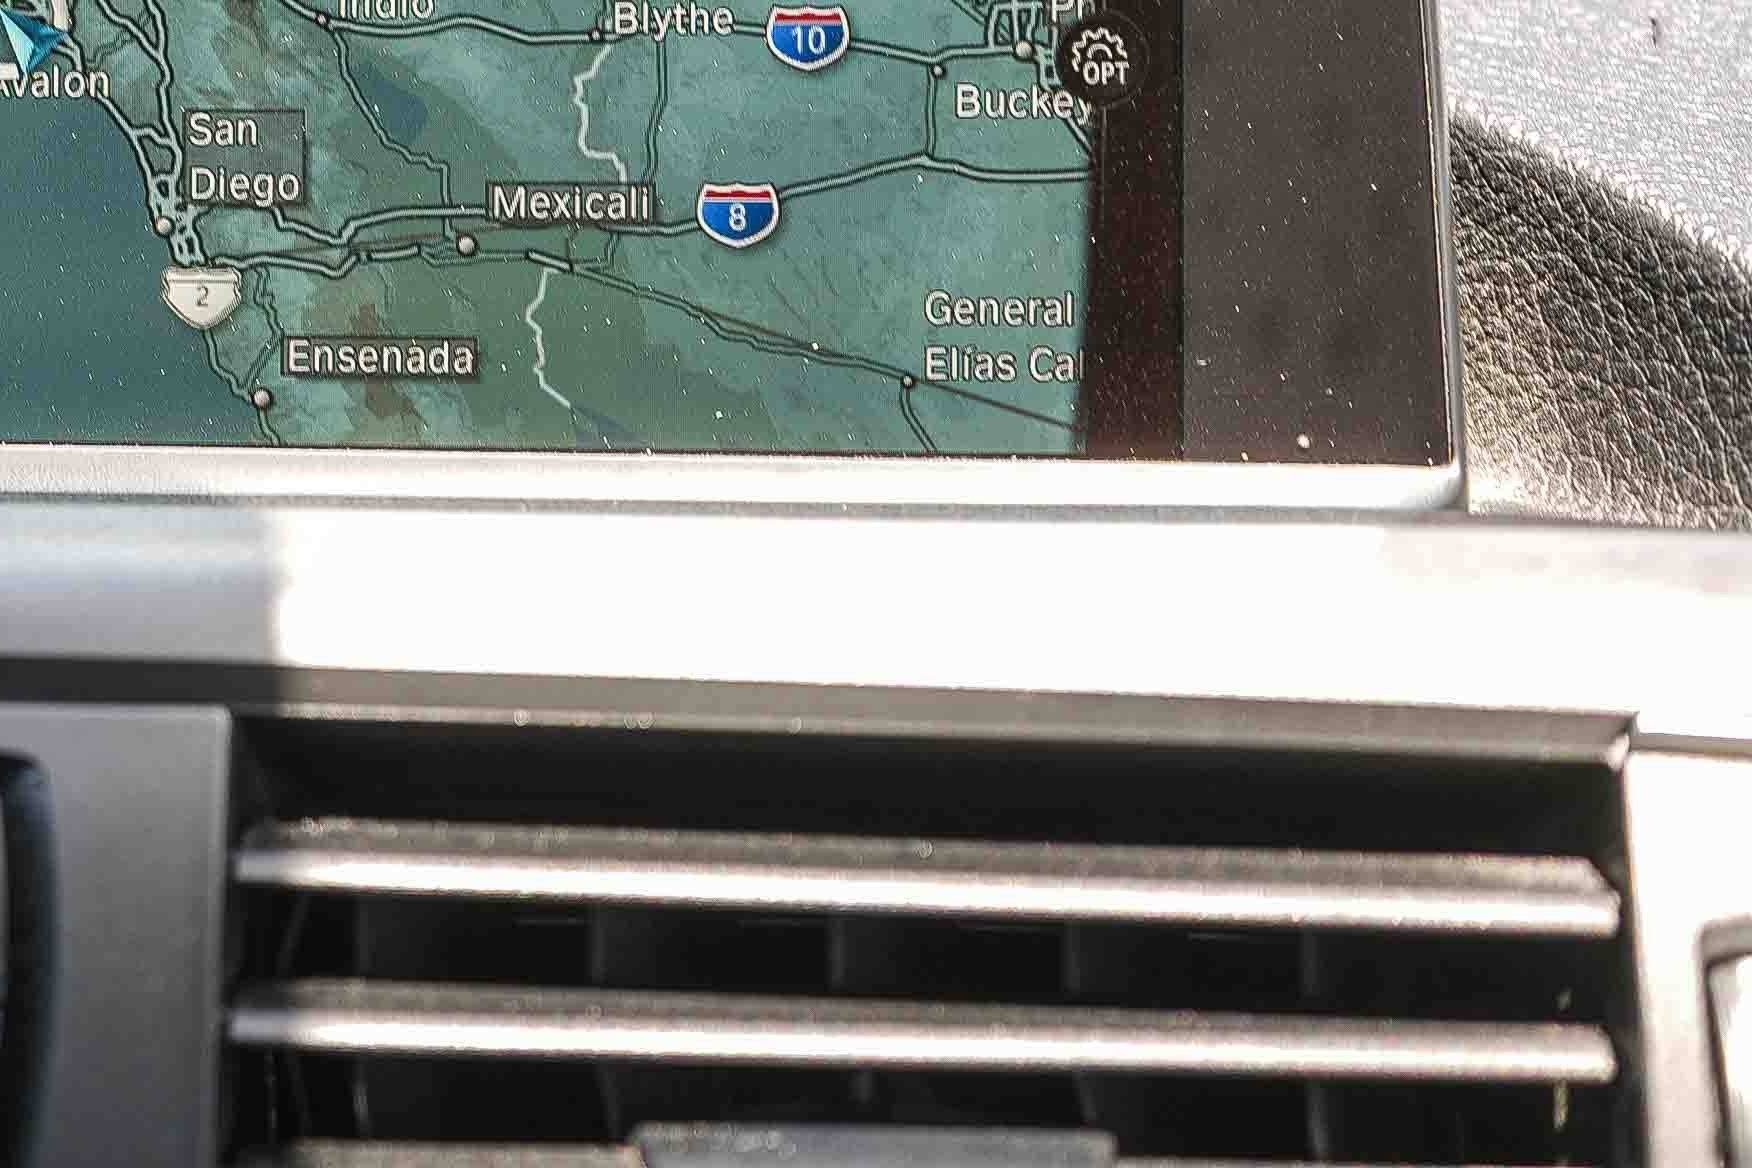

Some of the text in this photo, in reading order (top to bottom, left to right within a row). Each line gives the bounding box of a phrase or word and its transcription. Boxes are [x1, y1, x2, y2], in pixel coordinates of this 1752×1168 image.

[613, 1, 734, 42] Blythe
[791, 26, 826, 54] 10
[1082, 60, 1130, 86] OPT
[188, 112, 258, 146] San
[189, 167, 302, 207] Diego
[491, 185, 650, 221] Mexicali
[728, 203, 747, 231] 8
[194, 285, 210, 309] 2
[925, 288, 1074, 327] General
[286, 340, 474, 374] Ensenada
